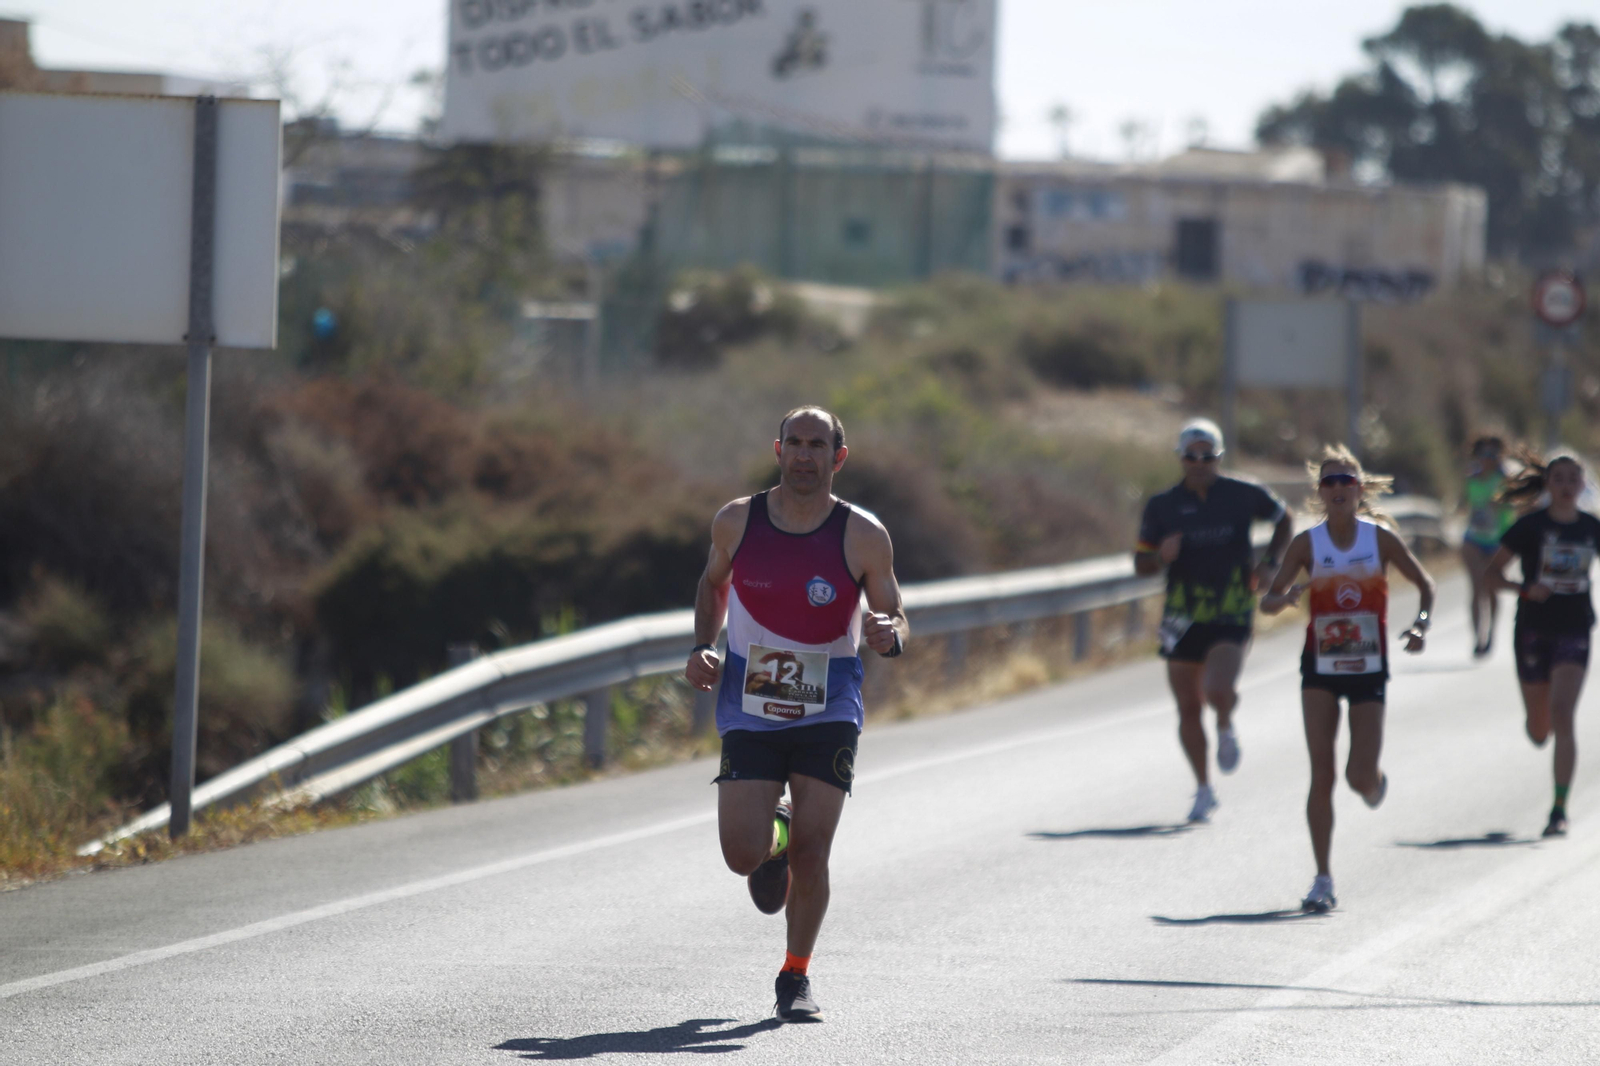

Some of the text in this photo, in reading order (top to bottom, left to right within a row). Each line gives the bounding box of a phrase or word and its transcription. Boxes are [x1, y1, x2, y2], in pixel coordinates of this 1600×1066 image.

[453, 24, 567, 75] TODO
[571, 18, 621, 53] EL
[767, 659, 798, 685] 12
